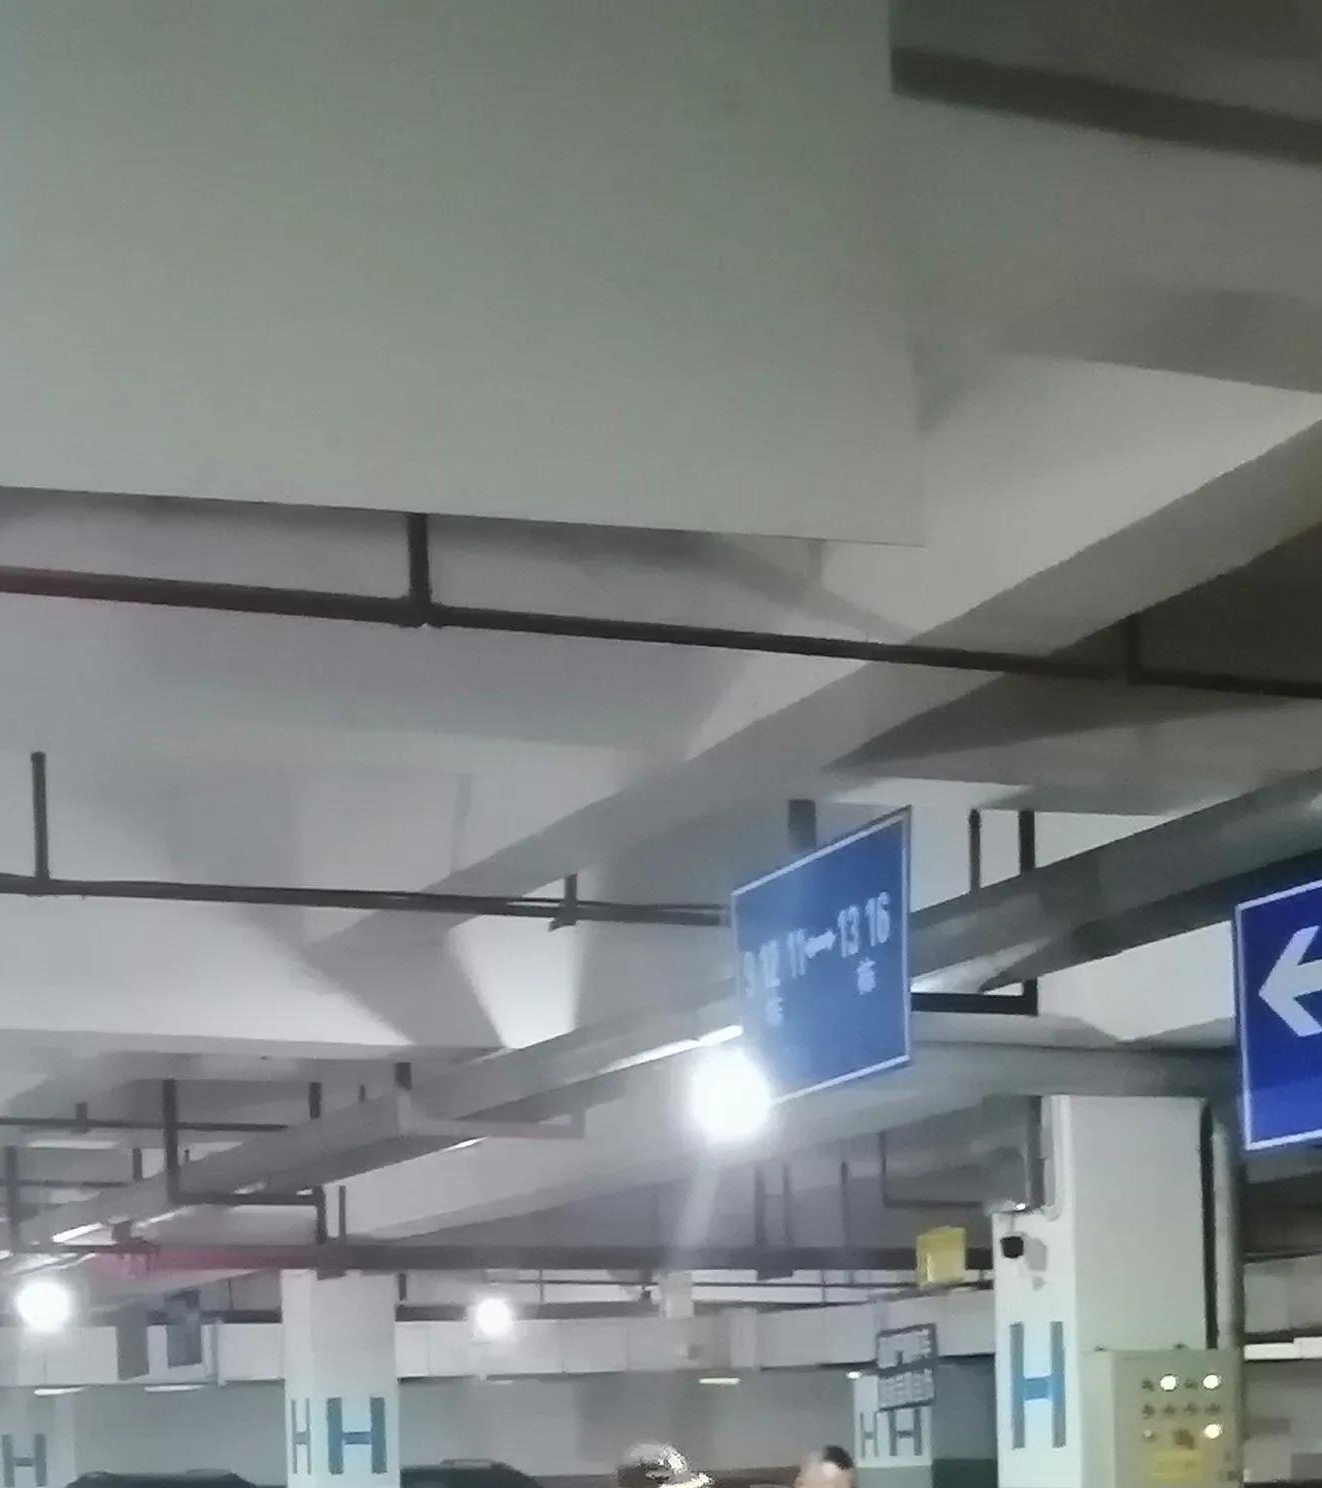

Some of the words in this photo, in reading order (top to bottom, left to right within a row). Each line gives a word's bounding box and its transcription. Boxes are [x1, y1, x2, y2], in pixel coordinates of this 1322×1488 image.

[1009, 1320, 1067, 1450] H
[2, 1433, 48, 1488] H
[326, 1396, 388, 1475] H
[888, 1407, 923, 1457] H
